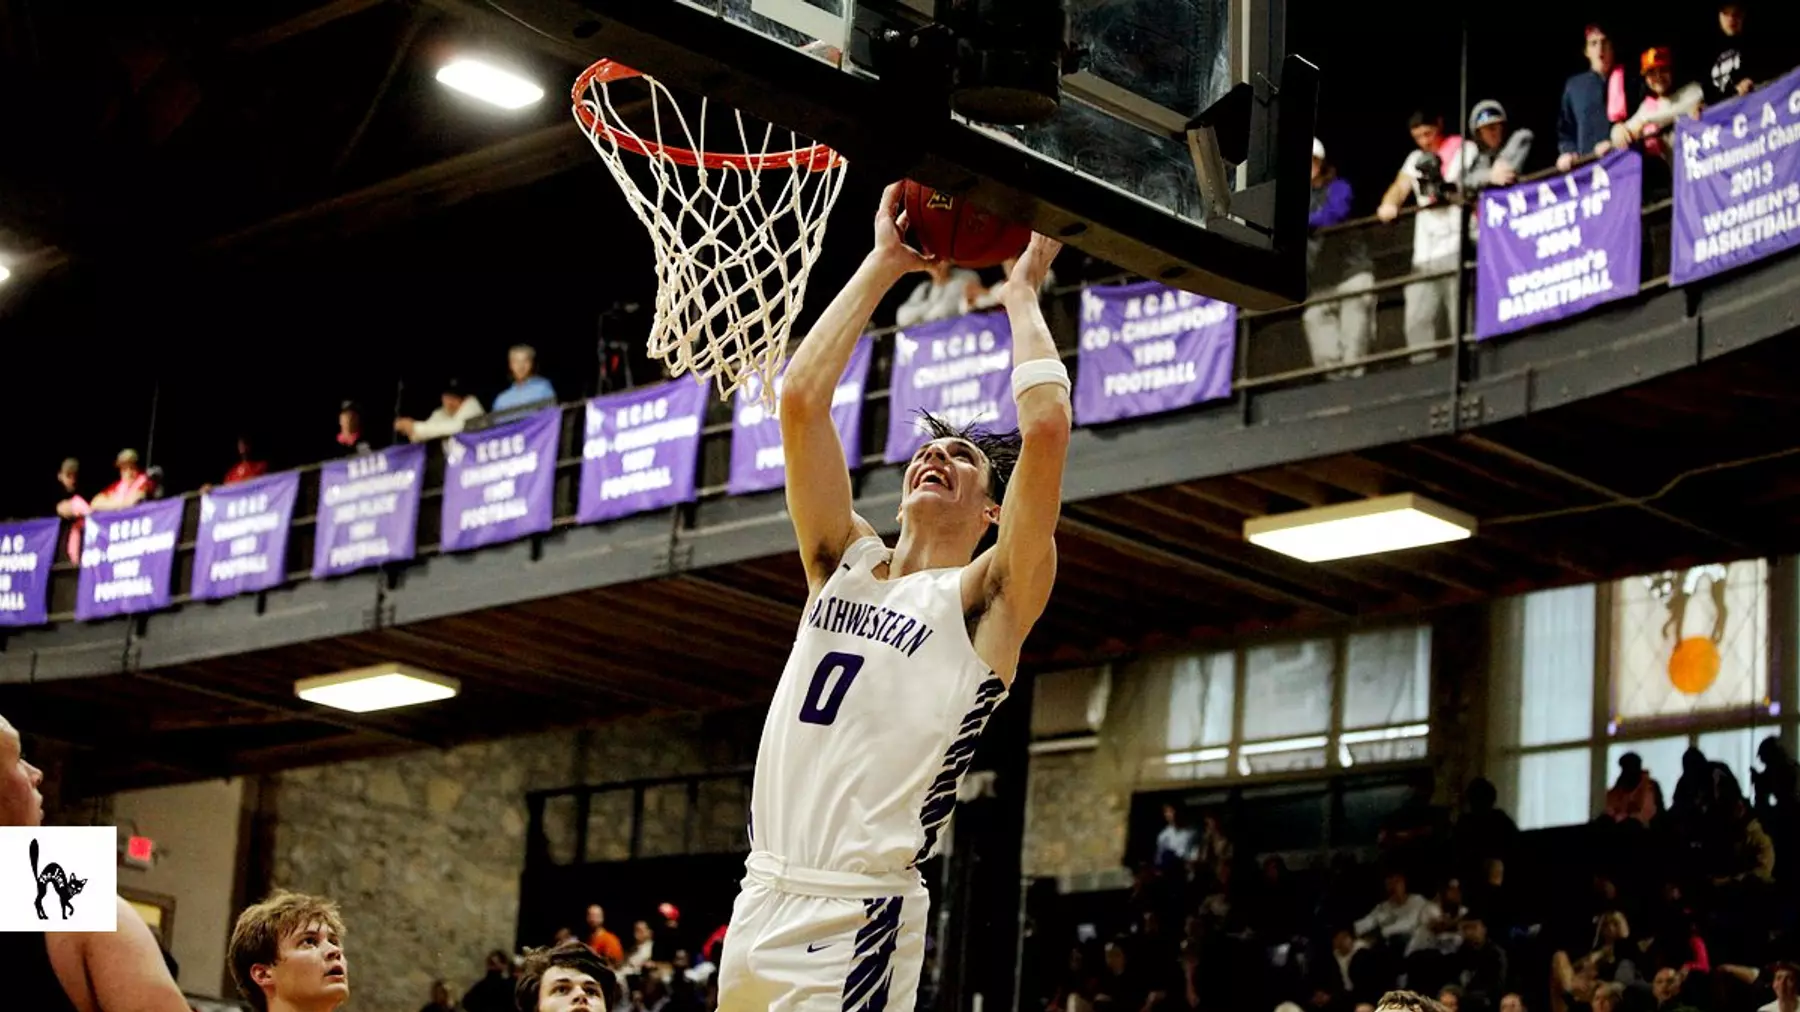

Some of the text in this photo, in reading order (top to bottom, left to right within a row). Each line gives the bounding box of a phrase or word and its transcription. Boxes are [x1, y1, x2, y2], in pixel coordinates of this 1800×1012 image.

[1685, 133, 1766, 182] Tournament
[1730, 160, 1774, 197] 2013
[1704, 182, 1799, 234] WOMEN'S
[1497, 268, 1614, 322] BASKETBALL
[1507, 249, 1608, 297] WOMEN'S
[1104, 361, 1196, 397] FOOTBALL
[600, 466, 673, 501] FOOTBALL
[460, 498, 528, 531] FOOTBALL
[799, 652, 865, 726] 0
